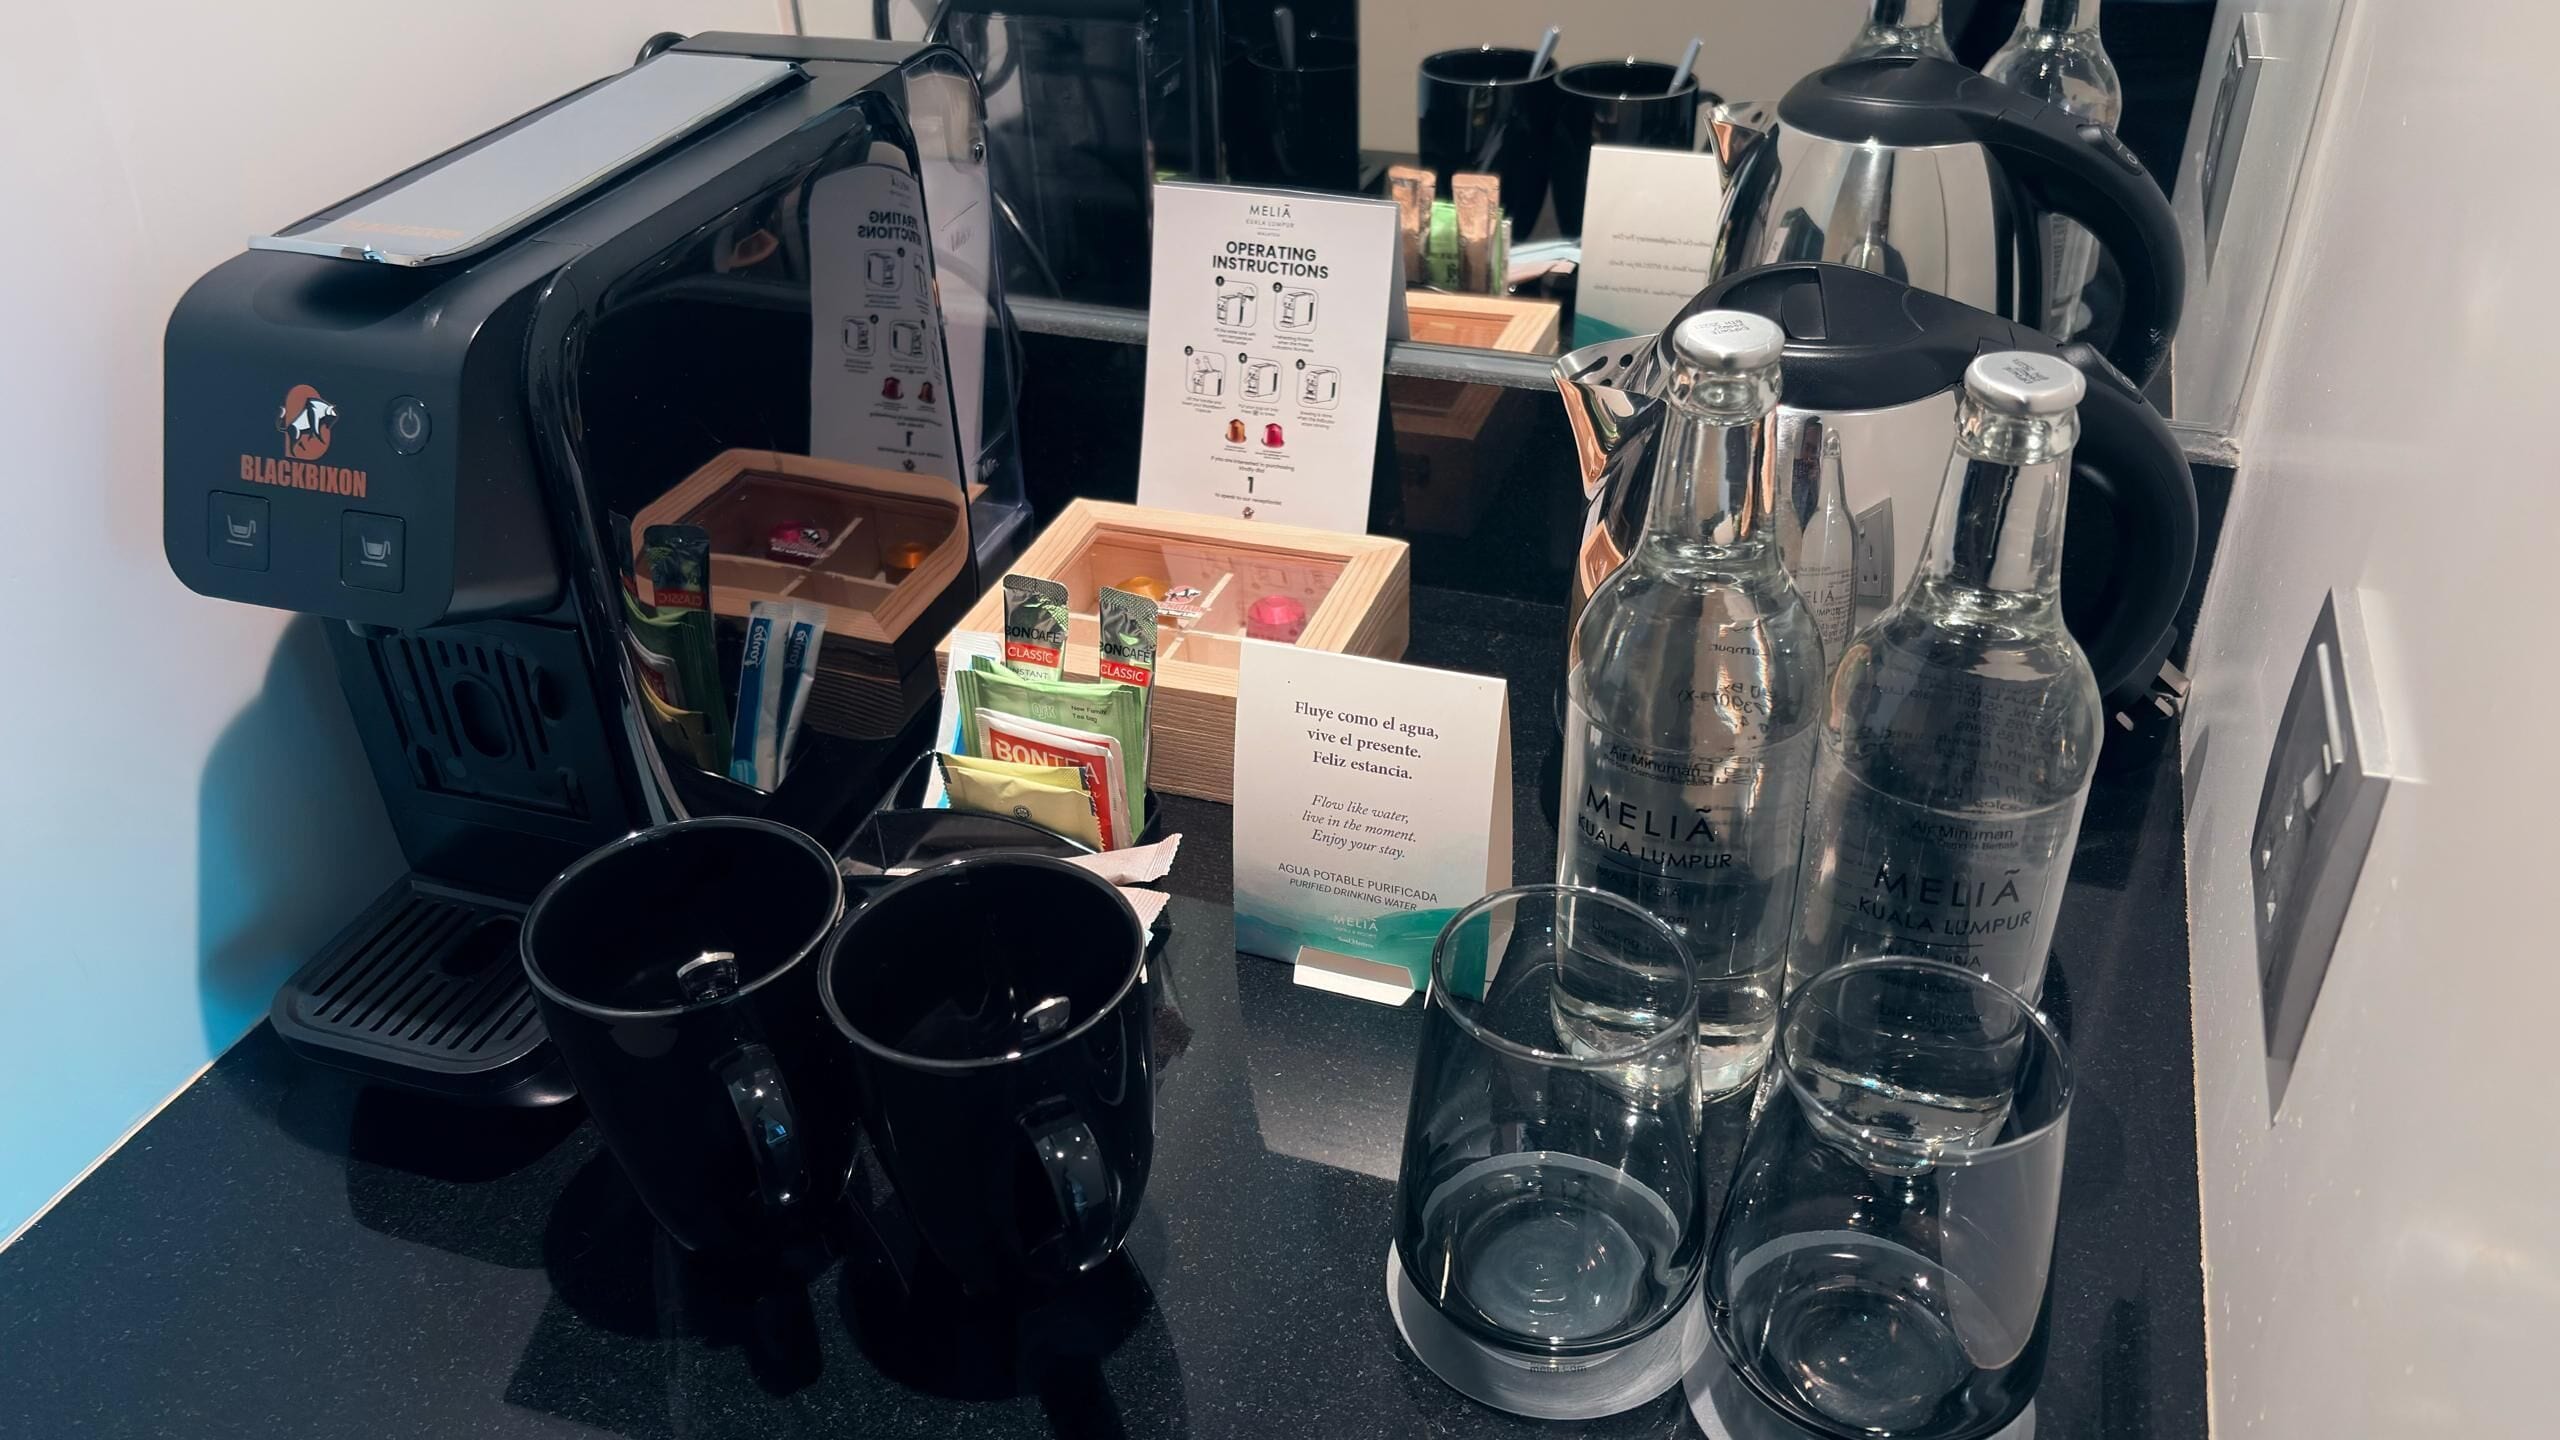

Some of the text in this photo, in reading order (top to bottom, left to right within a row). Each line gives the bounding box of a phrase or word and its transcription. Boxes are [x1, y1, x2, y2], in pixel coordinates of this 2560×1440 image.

[1212, 255, 1329, 280] INSTRUCTIONS
[1226, 241, 1317, 262] OPERATING
[240, 454, 367, 498] BLACKBIXON
[1247, 476, 1254, 494] 1
[1008, 646, 1055, 664] CLASSIC
[1100, 666, 1144, 683] CLASSIC
[1294, 701, 1439, 740] Fluye como el agua,
[1307, 728, 1421, 758] vive el presente.
[1313, 750, 1413, 780] Feliz estancia.
[1609, 744, 1628, 762] Air
[1631, 752, 1702, 778] Minuman
[1312, 794, 1409, 825] Flow like water,
[1586, 784, 1715, 843] MELIÃ
[1302, 810, 1416, 843] live in the moment.
[1578, 815, 1732, 869] KUALA LUMPUR
[1938, 825, 2014, 842] Minuman
[1311, 829, 1406, 861] Enjoy your stay.
[1278, 862, 1438, 904] AGUA POTABLE PURIFICADA
[1289, 878, 1417, 912] PURIFIED DRINKING WATER
[1873, 865, 2021, 908] MELIÃ
[1858, 896, 2033, 935] KUALA LUMPUR
